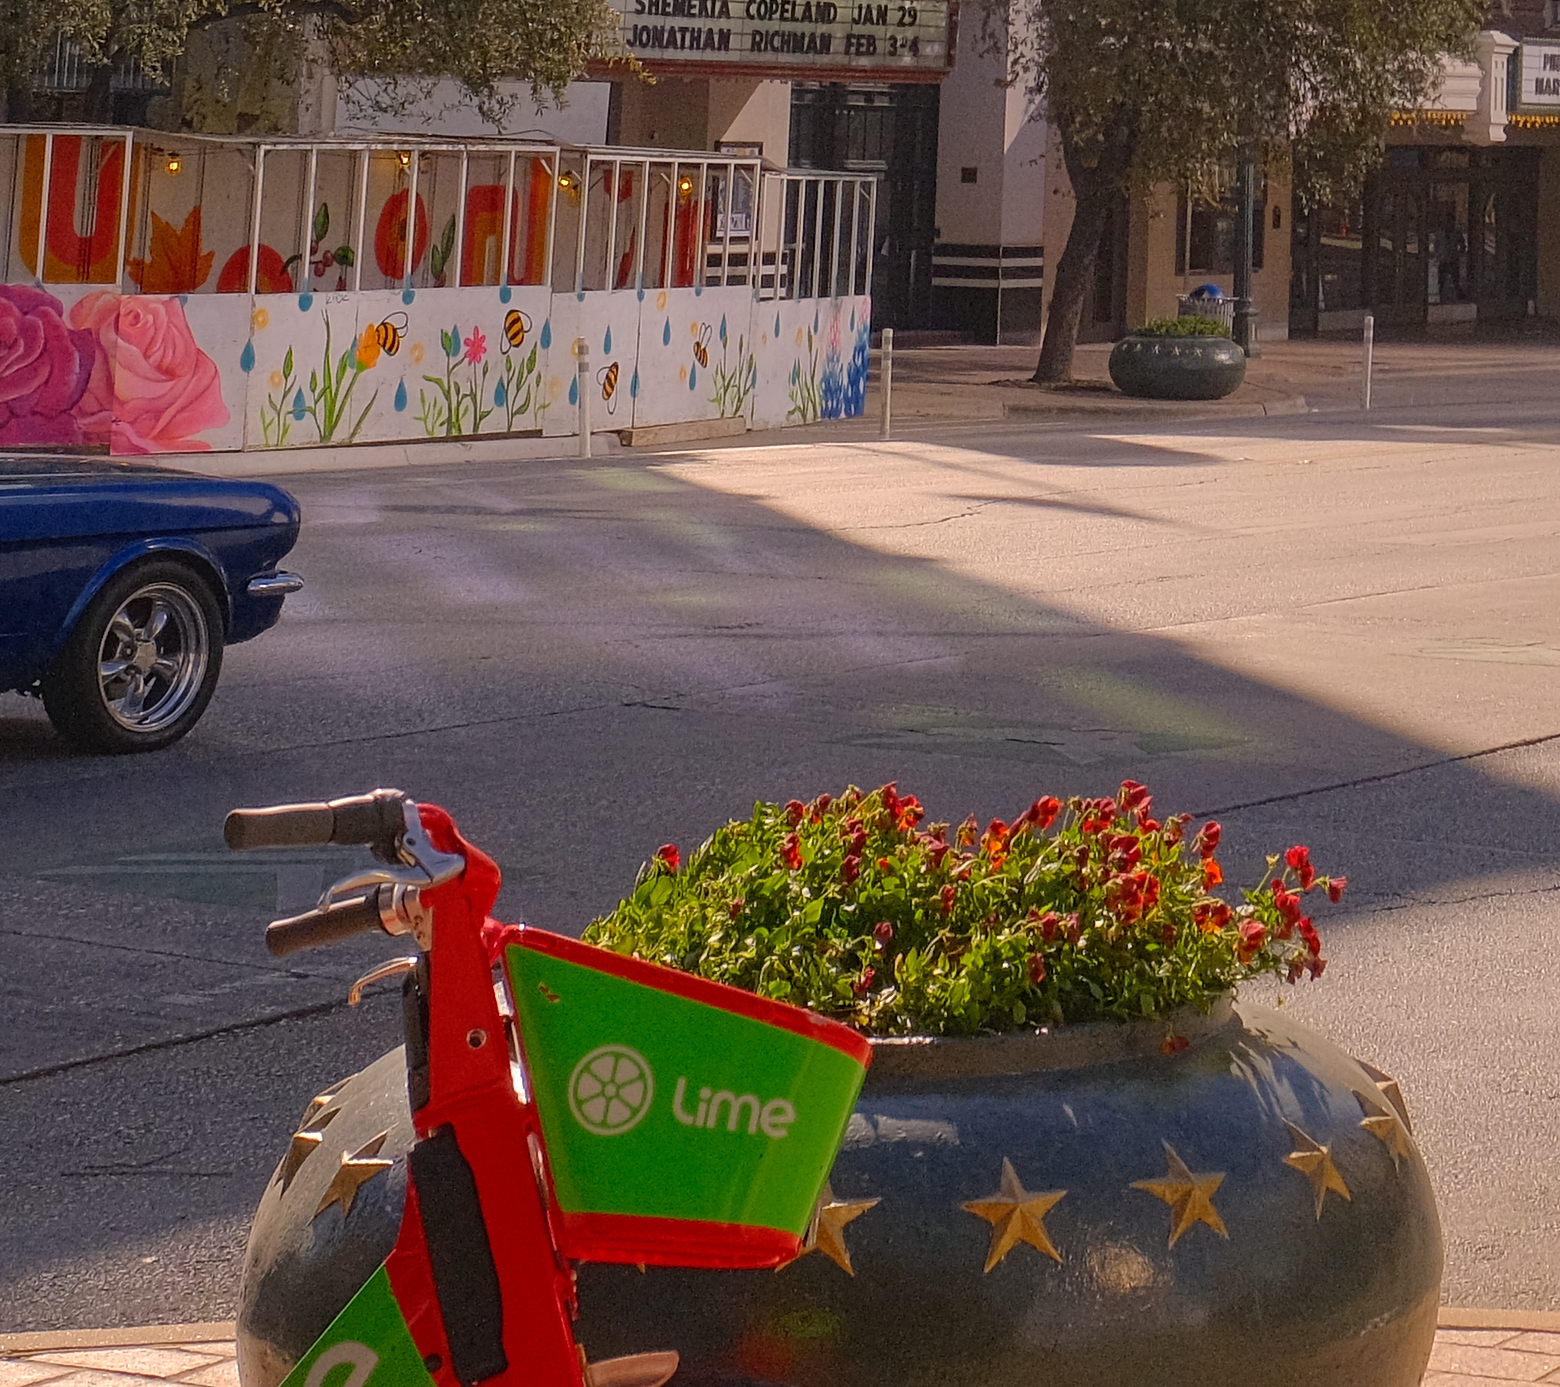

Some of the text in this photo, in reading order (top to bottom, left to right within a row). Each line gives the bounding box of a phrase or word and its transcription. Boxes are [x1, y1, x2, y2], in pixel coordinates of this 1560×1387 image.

[852, 3, 888, 26] JAN
[897, 5, 918, 27] 29
[626, 25, 731, 52] JONATHAN
[750, 29, 832, 55] RICHMAN
[844, 33, 877, 57] FEB
